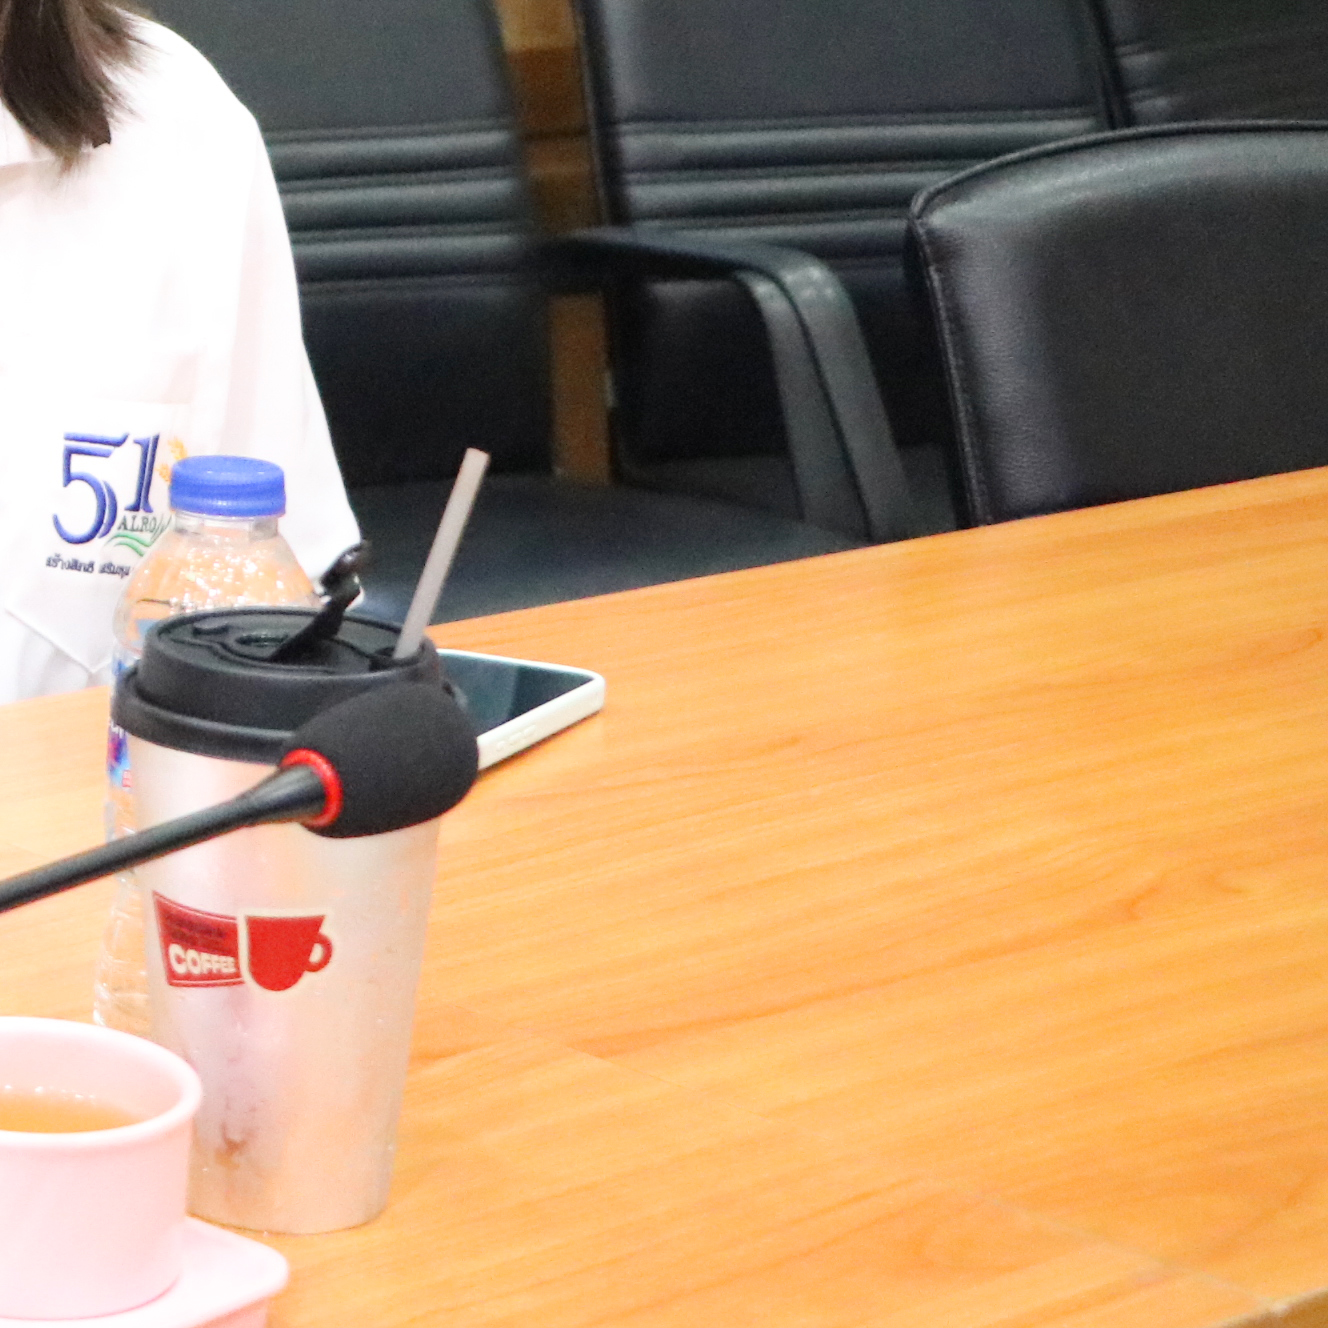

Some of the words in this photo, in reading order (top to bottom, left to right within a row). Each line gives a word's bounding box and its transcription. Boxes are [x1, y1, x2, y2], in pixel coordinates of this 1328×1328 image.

[52, 432, 160, 545] 51
[117, 514, 157, 533] ALRO
[168, 943, 236, 974] COFFEE
